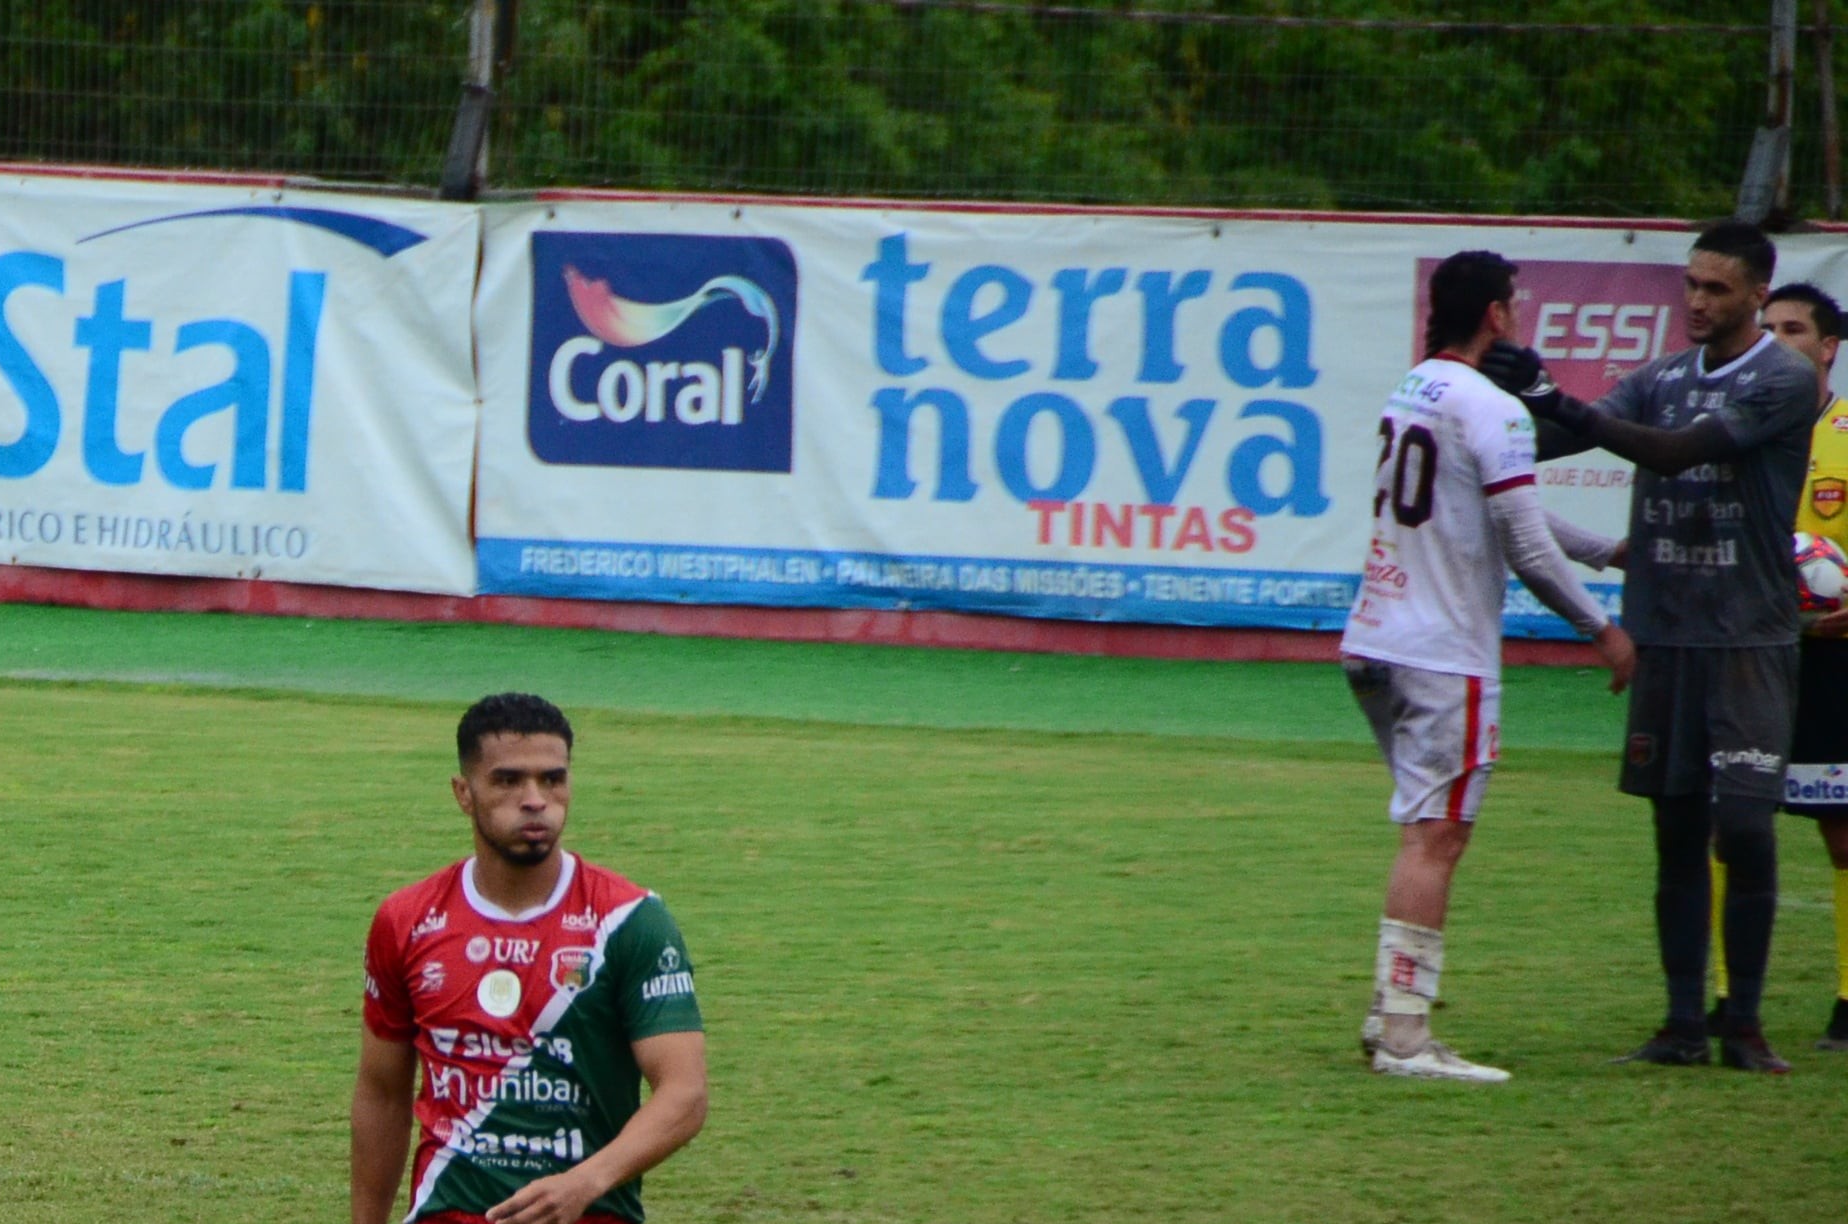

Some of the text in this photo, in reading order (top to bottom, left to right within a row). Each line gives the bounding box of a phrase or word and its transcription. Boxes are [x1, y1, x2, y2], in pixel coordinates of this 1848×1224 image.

[859, 231, 1320, 391] terra
[1533, 302, 1670, 361] ESSI
[549, 335, 743, 426] Coral
[868, 386, 1332, 518] nova
[73, 513, 87, 545] E
[96, 511, 309, 559] HIDRÁULICO
[1025, 501, 1257, 554] TINTAS
[519, 547, 651, 578] FREDERICO
[655, 552, 822, 585] WESTPHALEN
[958, 564, 1012, 592] DAS
[1141, 574, 1254, 606] TENENTE
[1257, 578, 1355, 609] PORTEL
[1784, 778, 1848, 800] Delta
[447, 1118, 584, 1162] Barril
